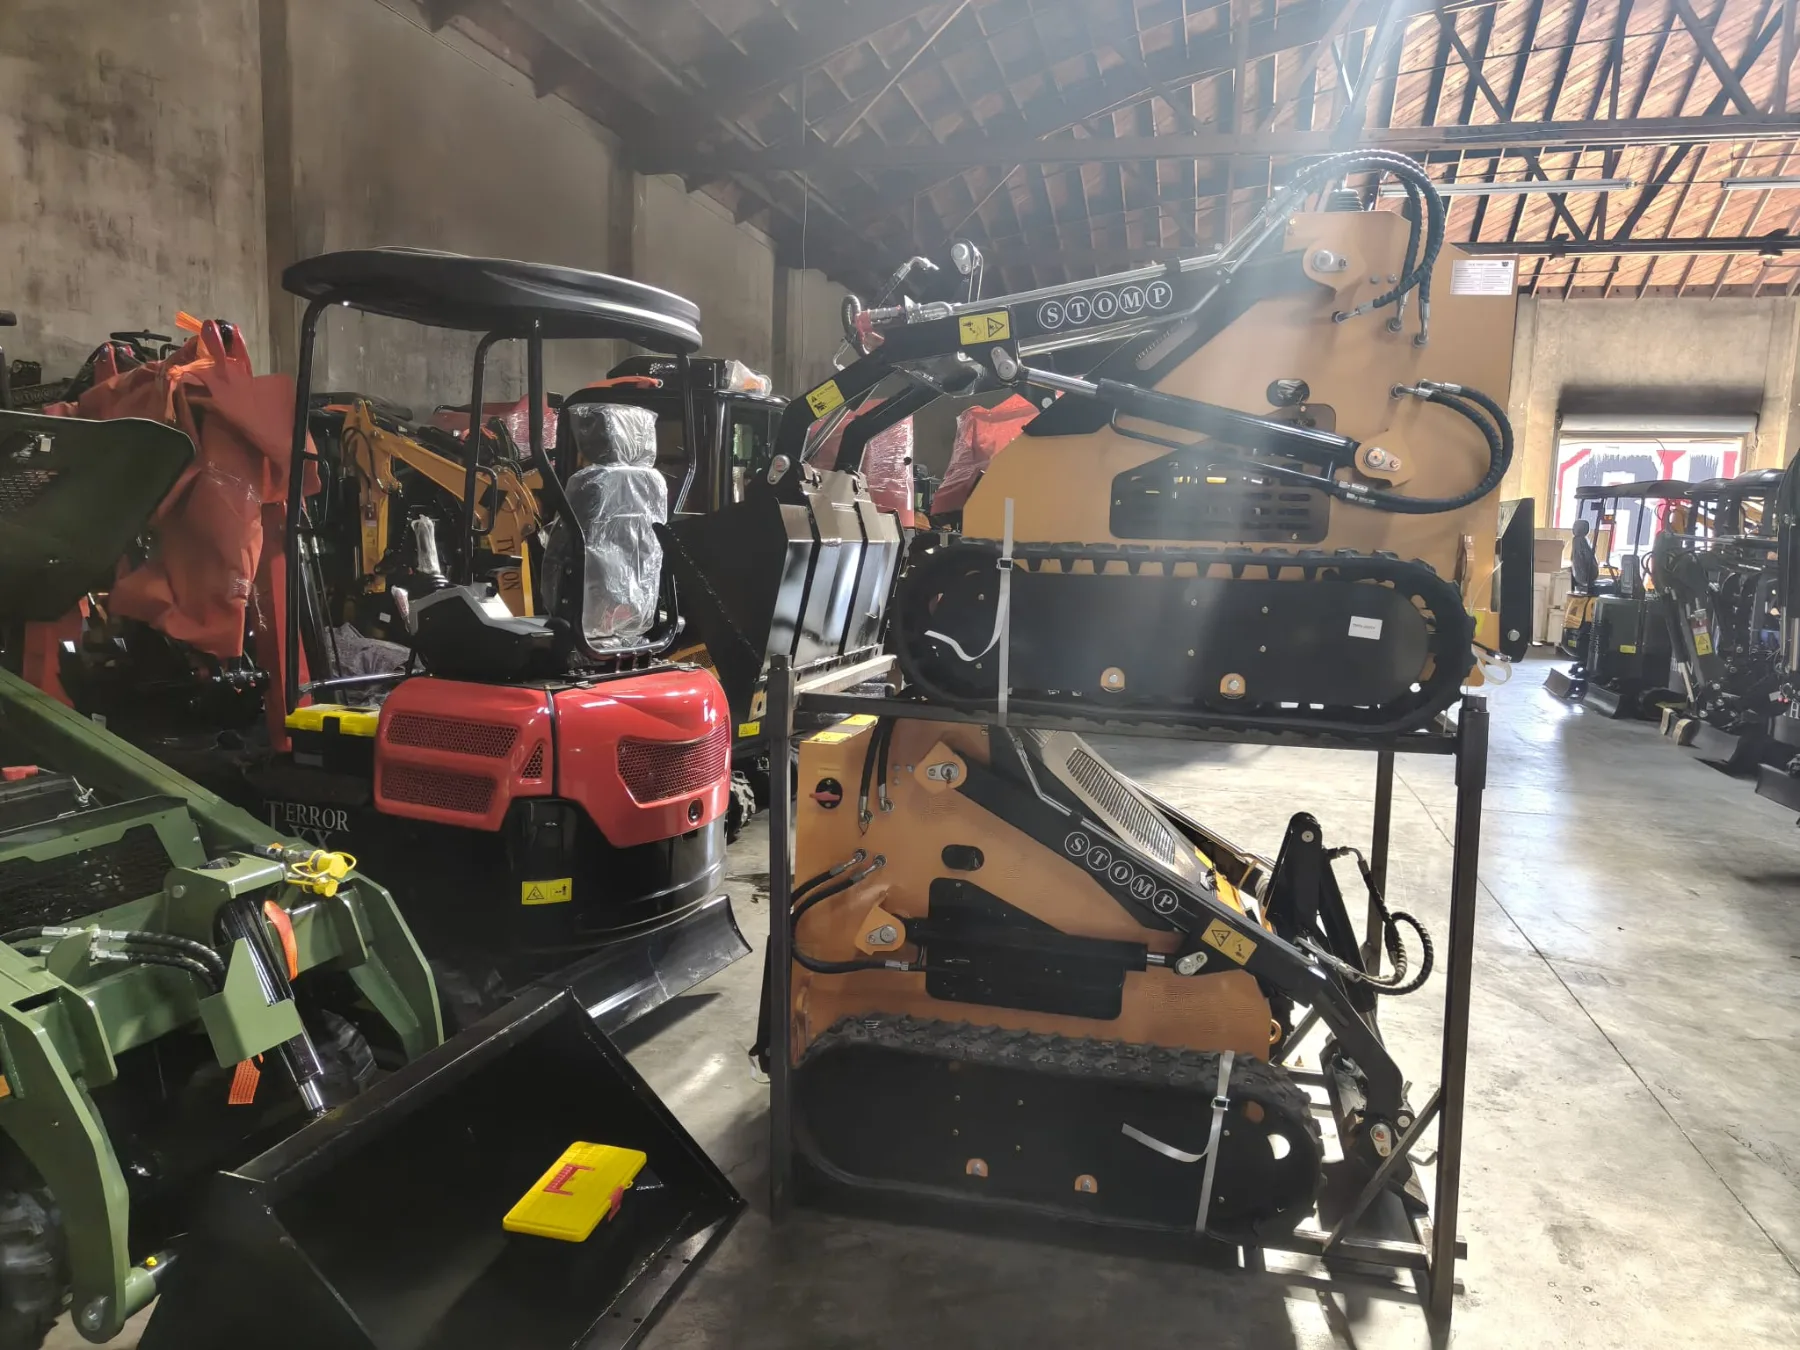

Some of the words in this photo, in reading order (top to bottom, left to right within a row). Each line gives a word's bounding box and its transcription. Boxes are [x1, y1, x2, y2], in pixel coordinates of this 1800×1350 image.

[1039, 281, 1172, 329] STOMP
[497, 537, 520, 591] TYON
[263, 800, 350, 832] TERROR
[1065, 832, 1178, 914] STOMP
